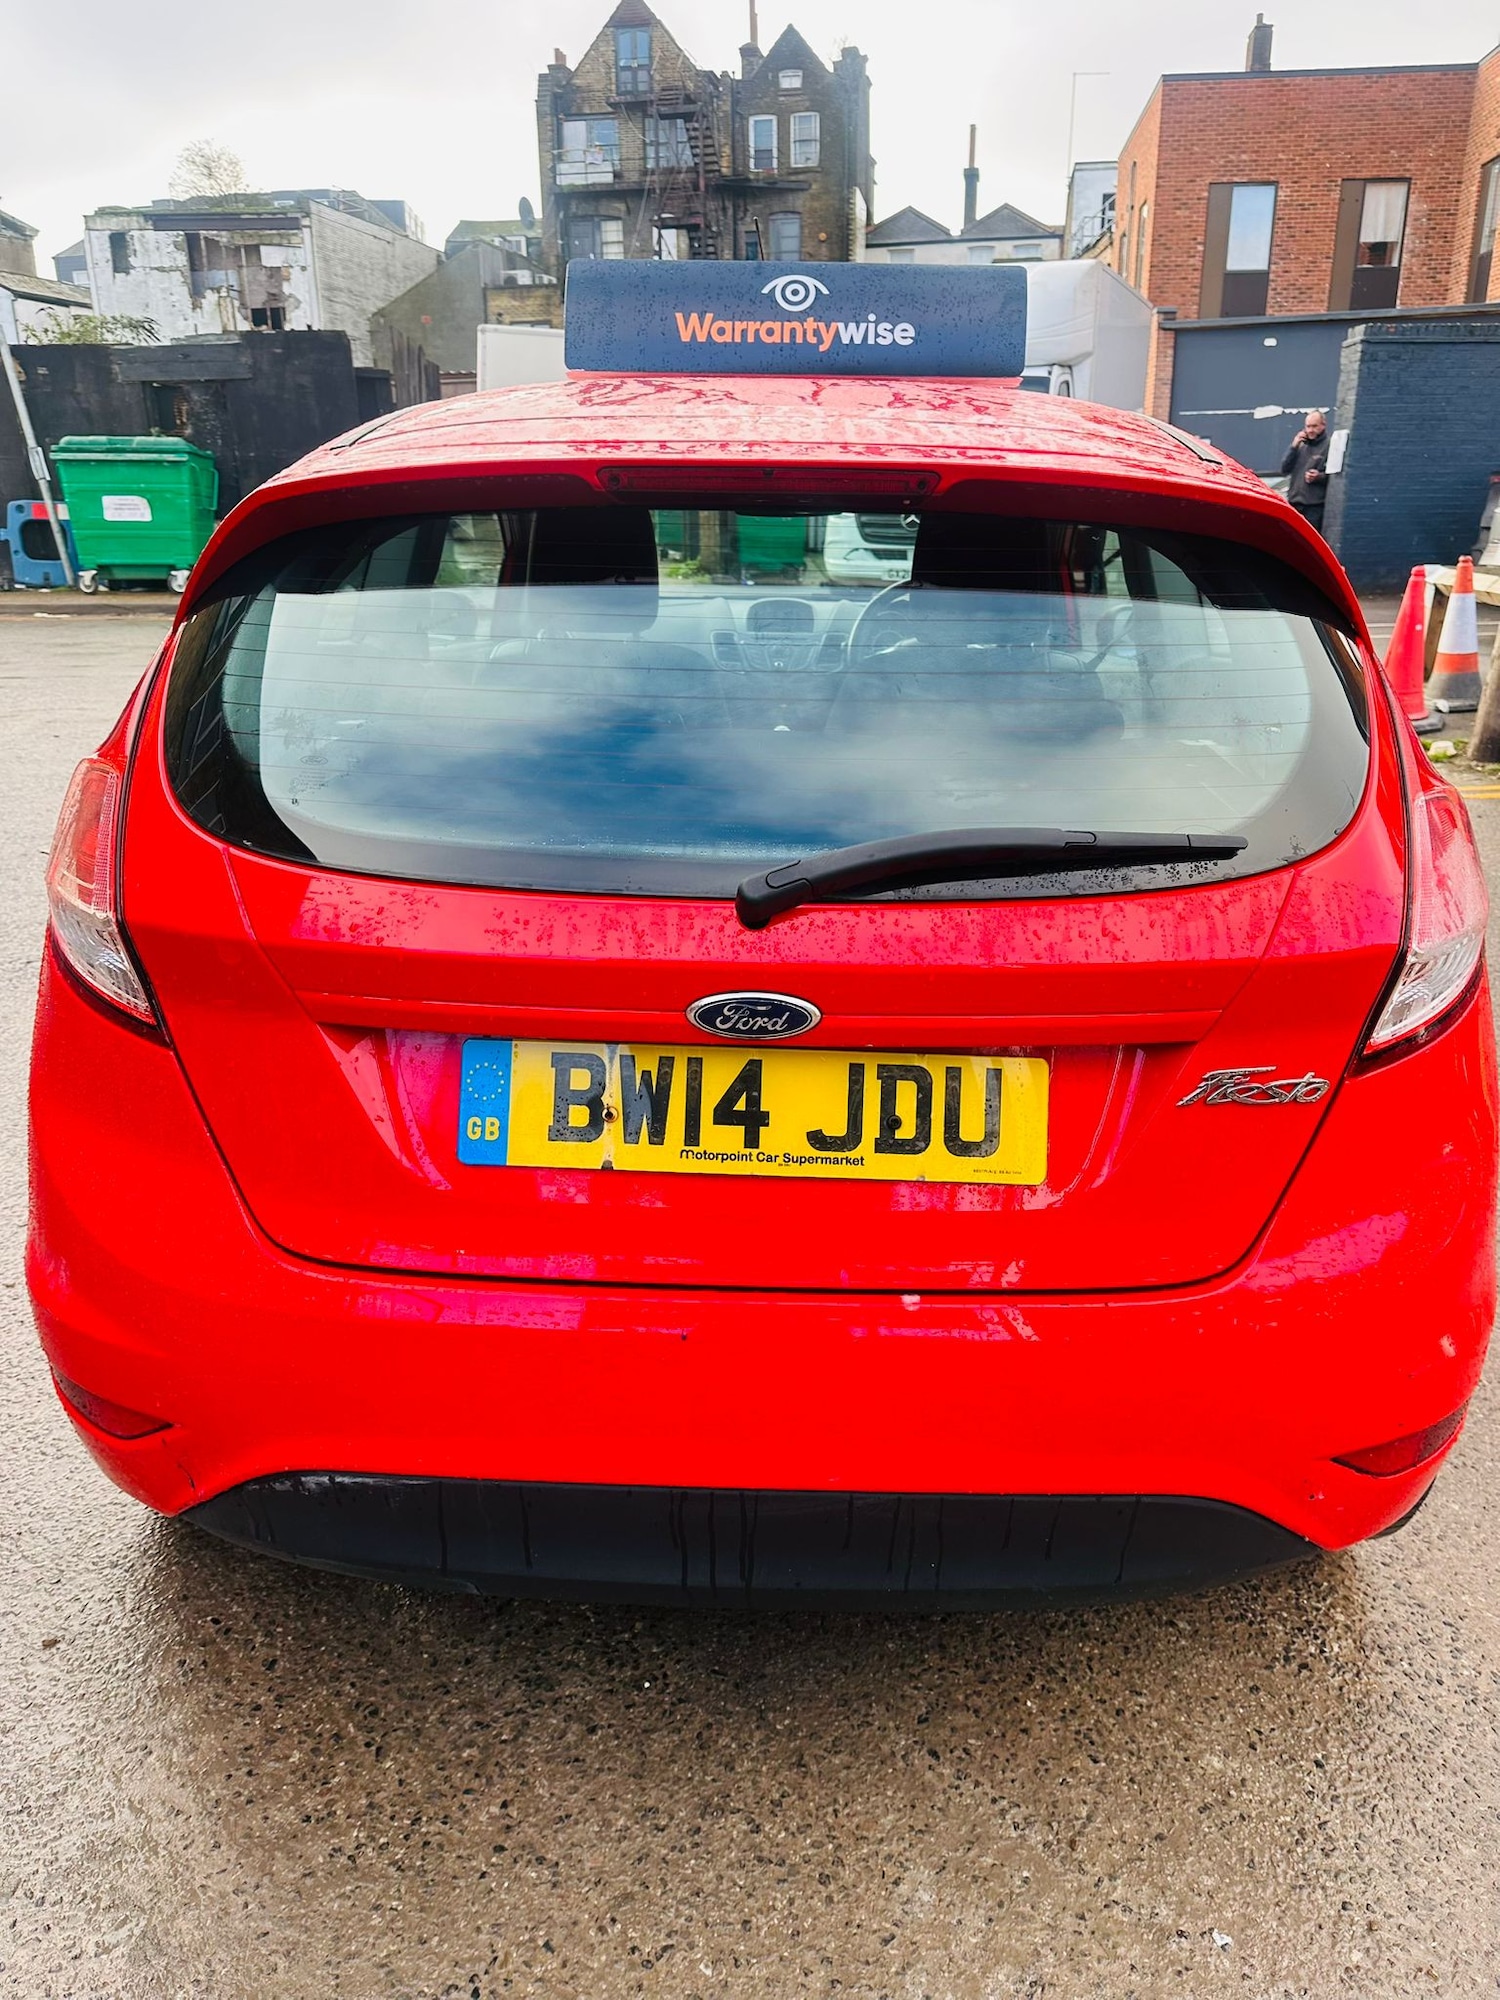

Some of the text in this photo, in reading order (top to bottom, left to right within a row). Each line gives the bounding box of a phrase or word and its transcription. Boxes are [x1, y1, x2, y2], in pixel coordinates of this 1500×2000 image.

[674, 312, 917, 352] Warrantywise
[716, 1003, 790, 1031] Ford
[1176, 1066, 1330, 1106] Fiesta
[548, 1052, 1002, 1158] BW14 JDU
[467, 1116, 500, 1141] GB
[680, 1149, 865, 1167] Motorpoint Car Supermarket
